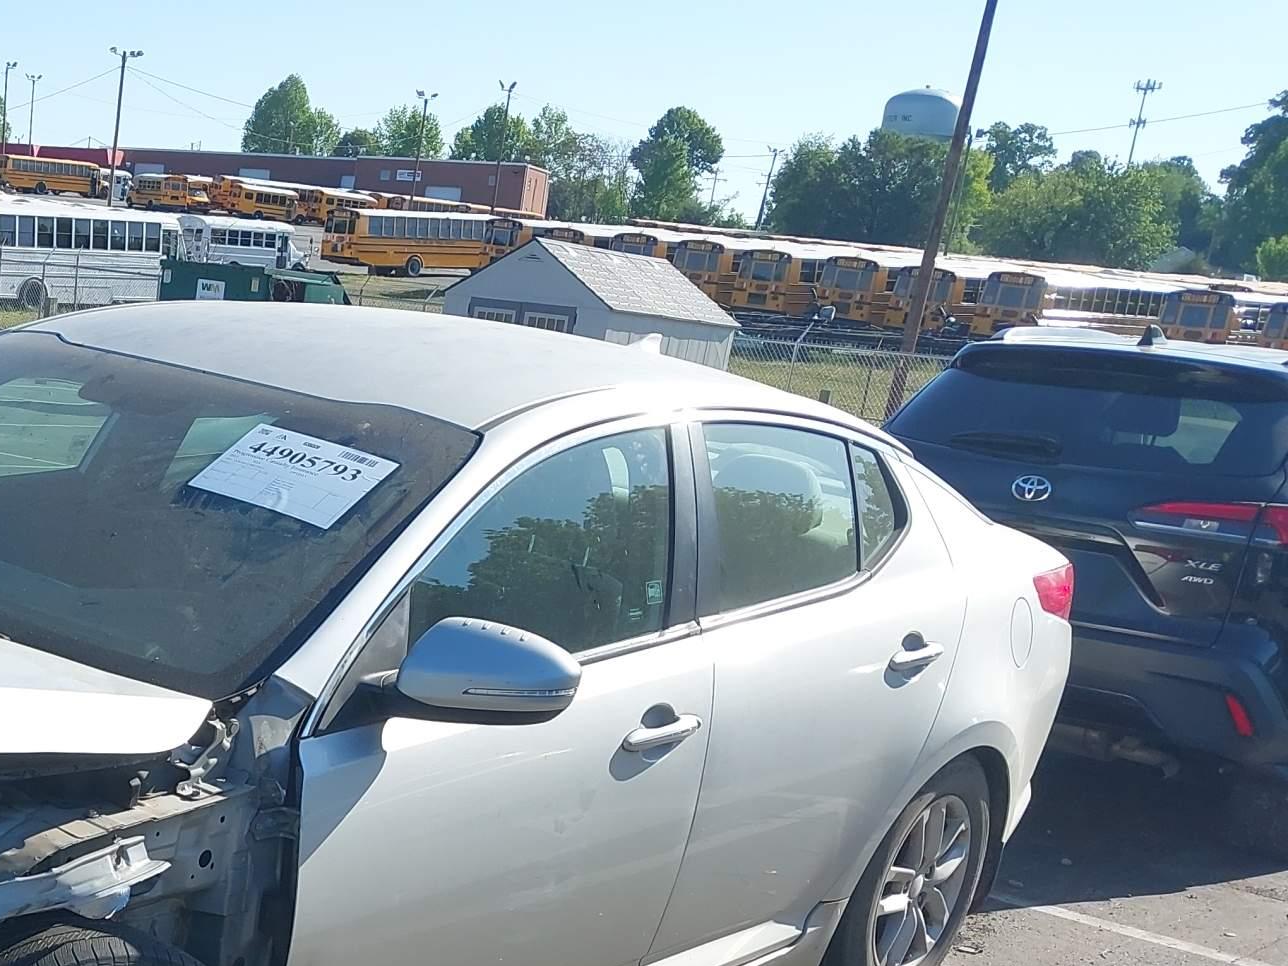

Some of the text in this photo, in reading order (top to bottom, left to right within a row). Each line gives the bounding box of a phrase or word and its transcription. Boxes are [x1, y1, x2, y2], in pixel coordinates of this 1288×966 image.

[248, 440, 363, 483] 44905793
[1184, 559, 1222, 572] XLE
[1181, 575, 1214, 585] AWD
